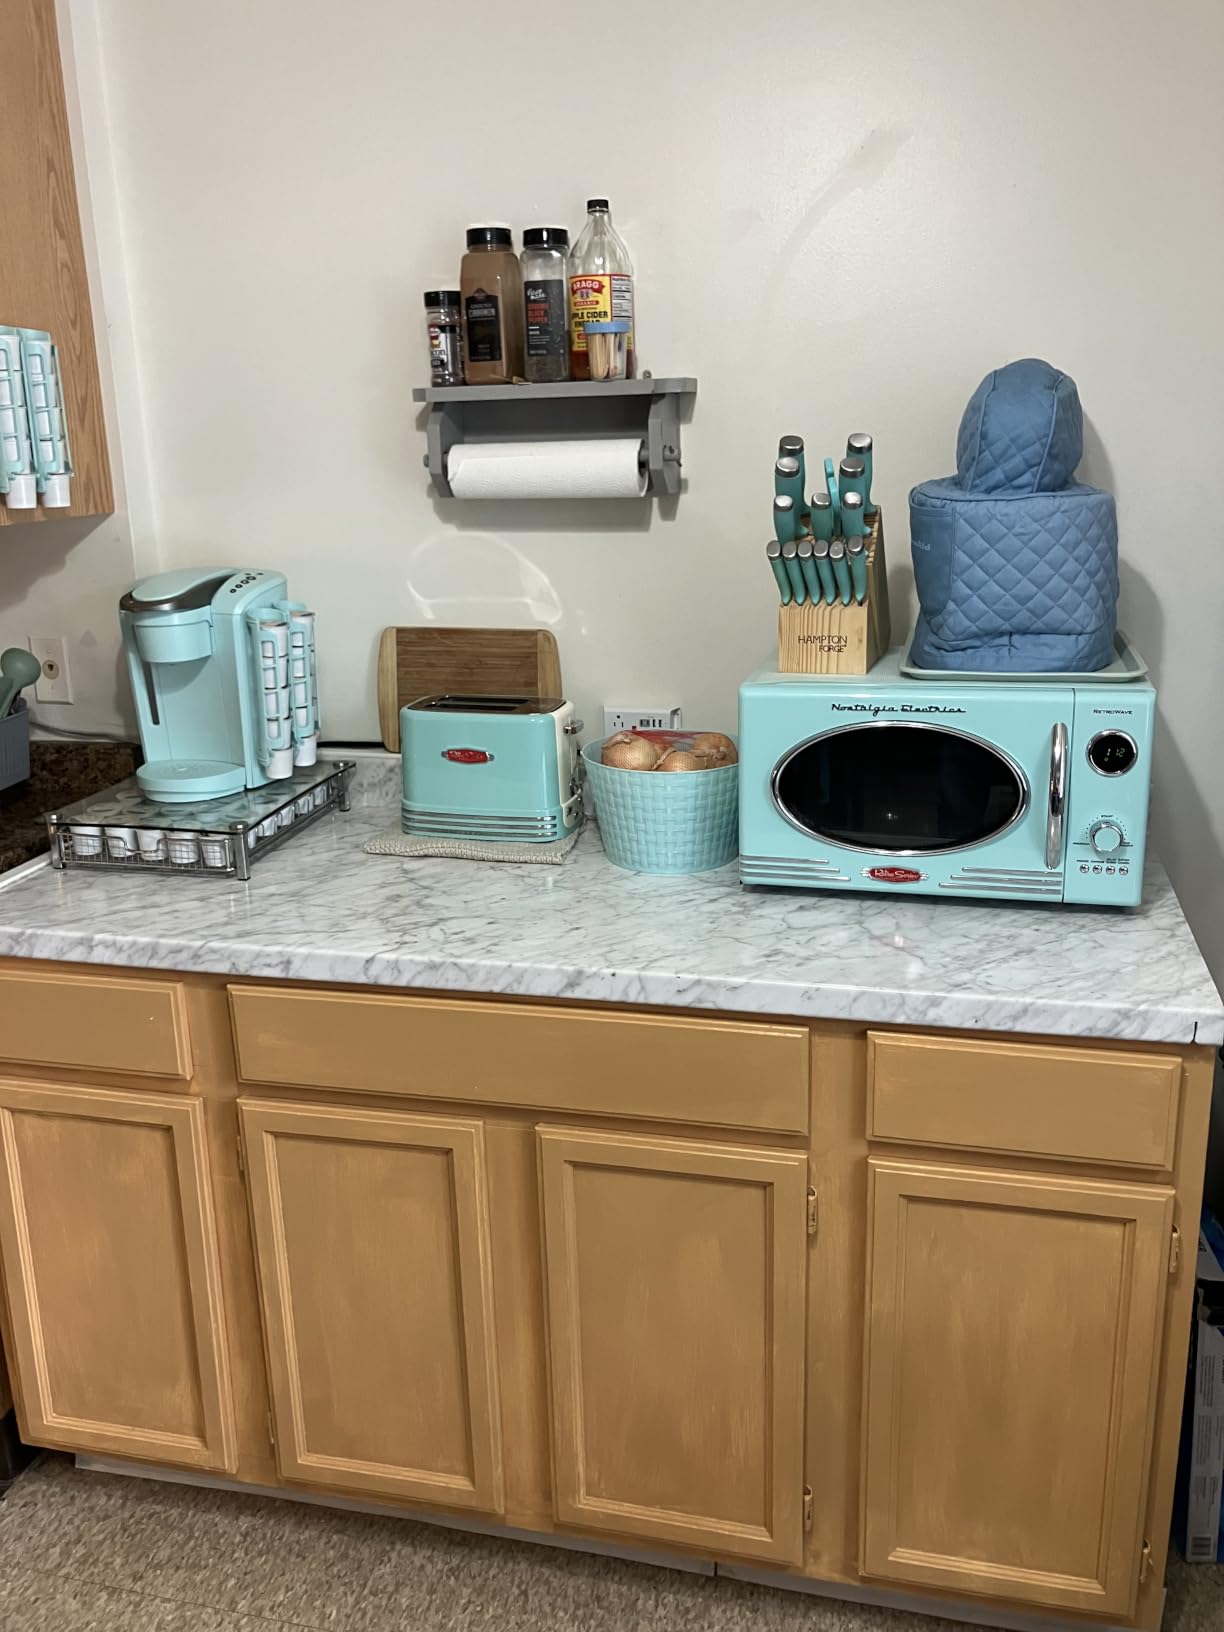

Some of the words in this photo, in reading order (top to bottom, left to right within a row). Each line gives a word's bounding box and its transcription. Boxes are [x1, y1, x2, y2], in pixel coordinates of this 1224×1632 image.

[573, 280, 600, 290] BRAGG
[586, 310, 609, 319] CIDER
[798, 634, 848, 645] HAMPTON
[819, 644, 845, 653] FORGE
[831, 703, 899, 717] Nostalgia
[900, 704, 967, 713] Electrics
